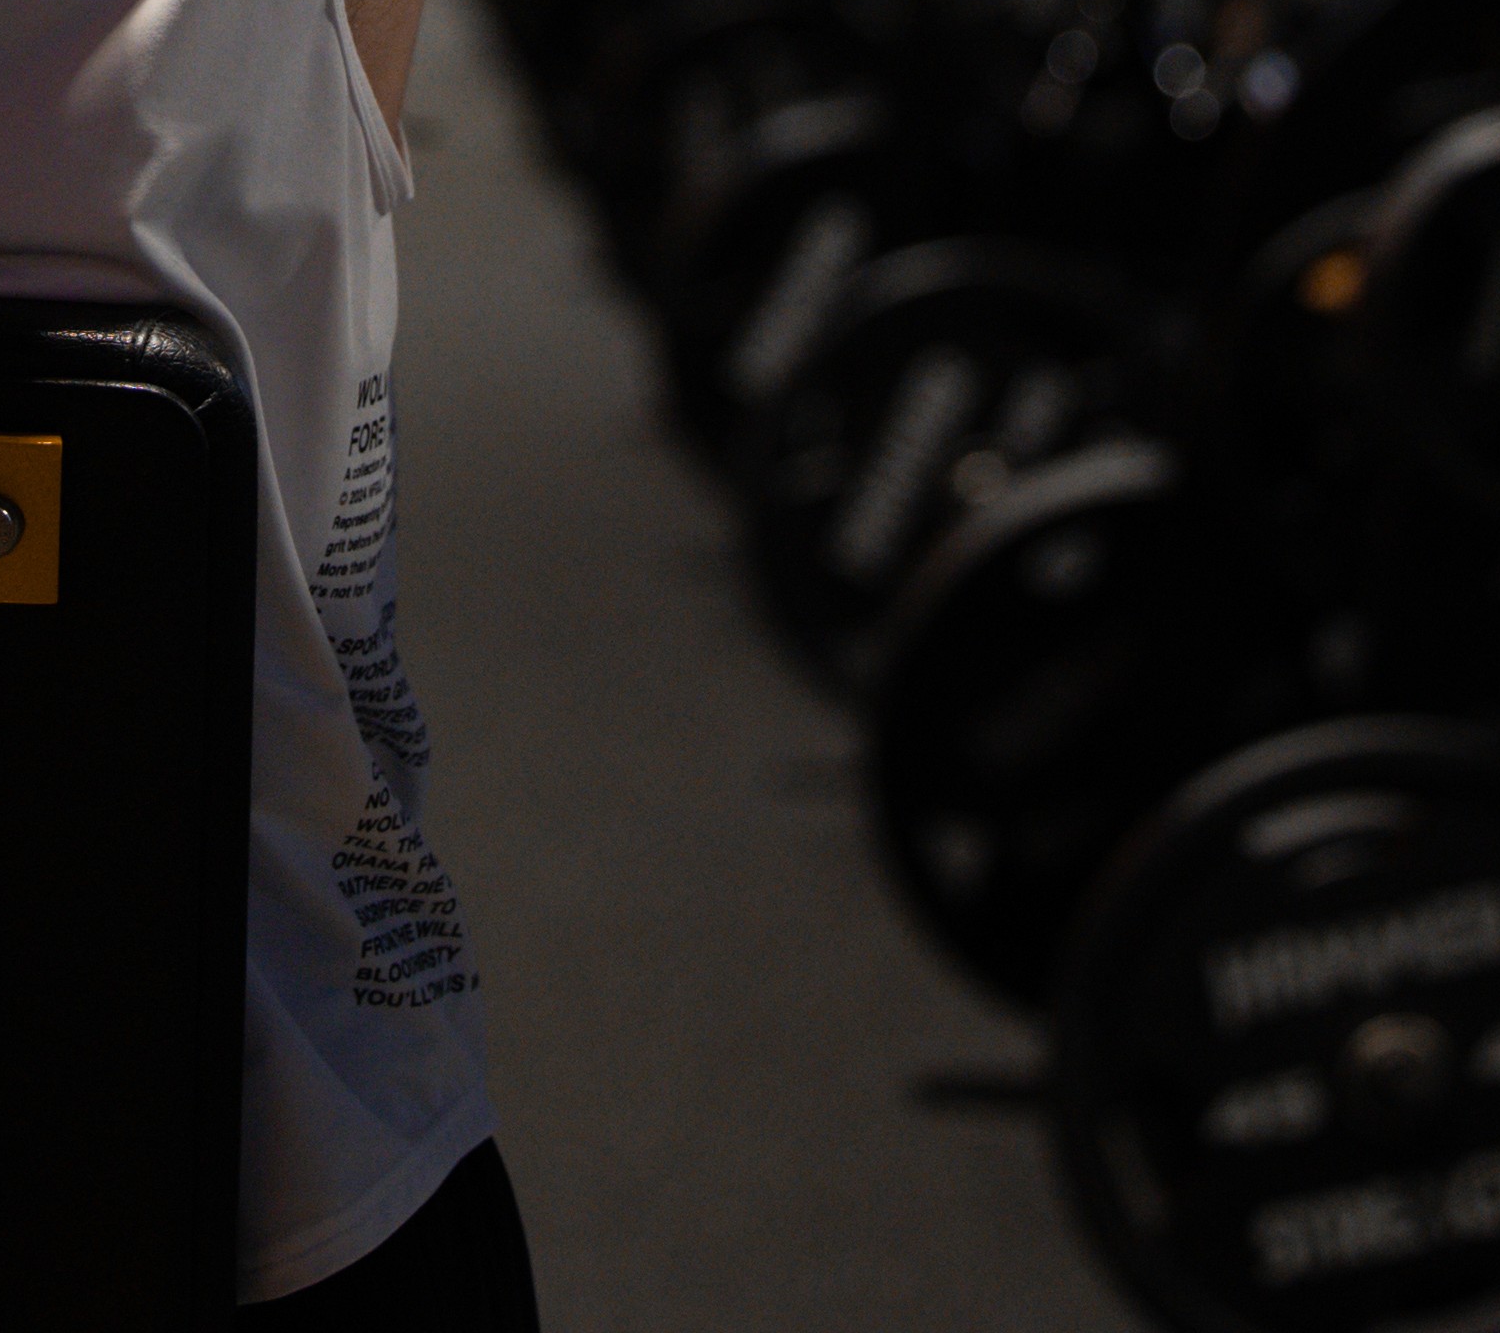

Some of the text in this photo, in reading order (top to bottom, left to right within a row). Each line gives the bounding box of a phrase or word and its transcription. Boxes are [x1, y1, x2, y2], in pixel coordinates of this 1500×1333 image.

[325, 538, 346, 557] grit
[317, 563, 348, 576] More
[330, 586, 350, 598] not
[344, 835, 388, 852] TILL
[332, 852, 408, 873] OHANA
[431, 897, 456, 915] TO
[416, 920, 462, 938] WILL
